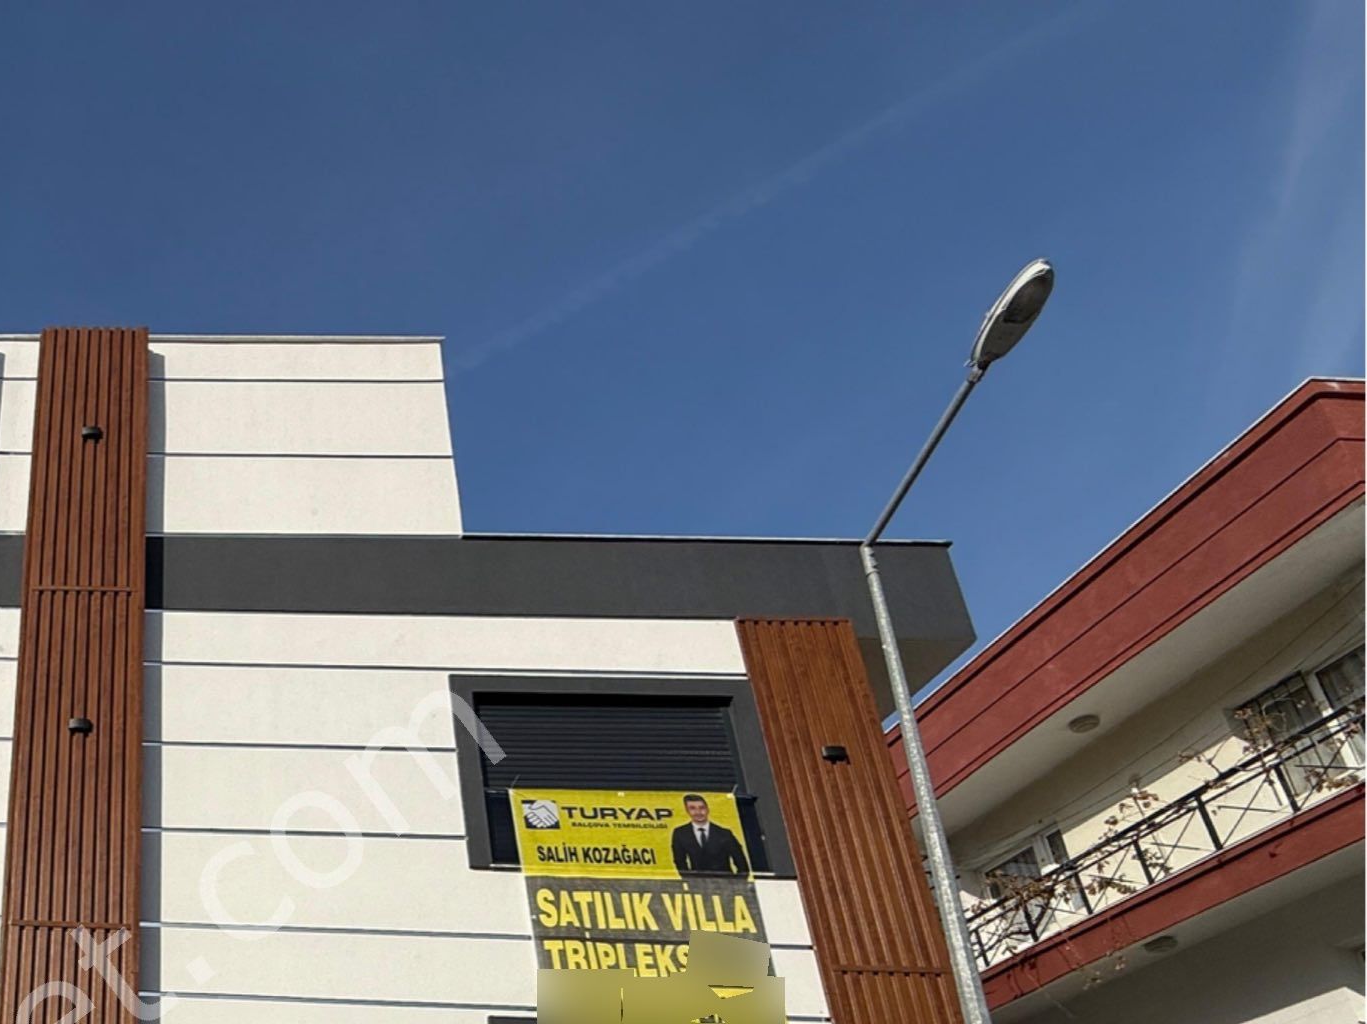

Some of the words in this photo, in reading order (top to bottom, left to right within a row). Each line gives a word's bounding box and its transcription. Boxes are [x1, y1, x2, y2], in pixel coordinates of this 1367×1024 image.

[561, 806, 673, 821] TURYAP
[537, 842, 580, 862] SALİH
[582, 844, 657, 865] KOZAĞACI
[536, 887, 660, 931] SATILIK
[661, 883, 758, 934] VİLLA
